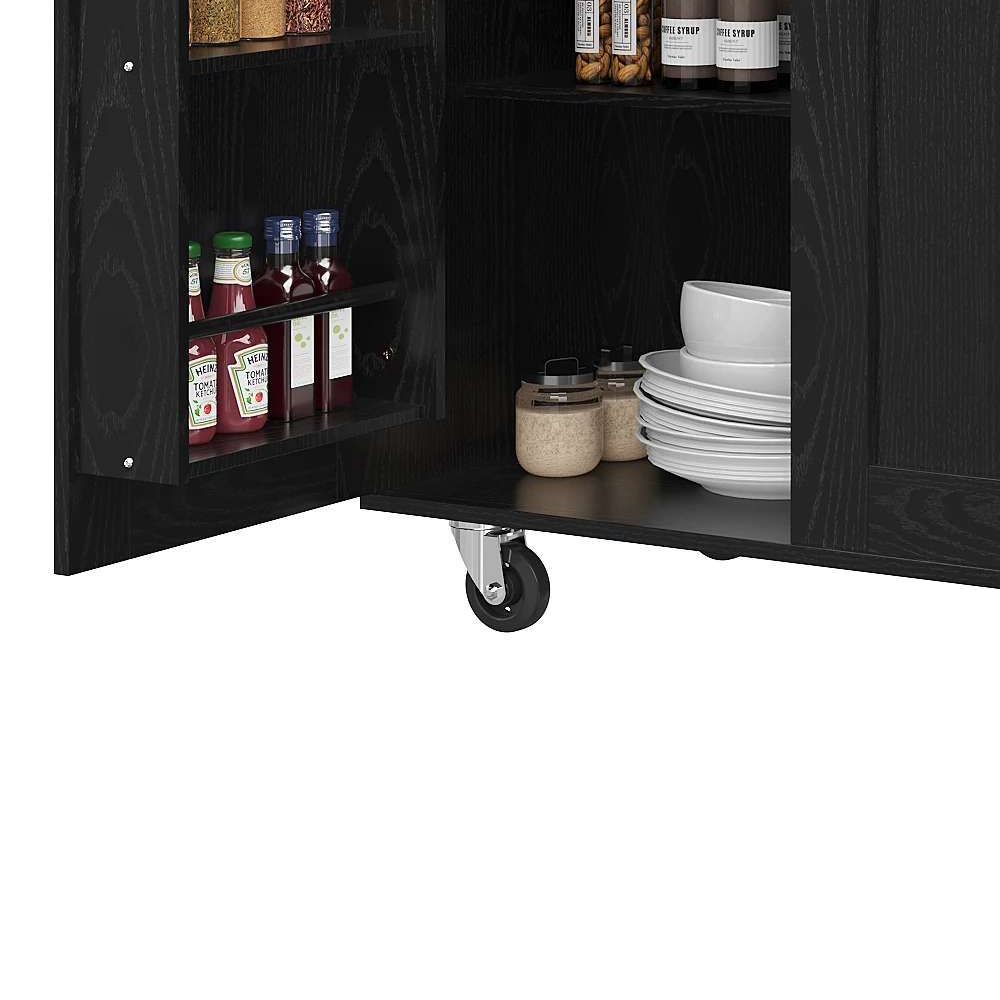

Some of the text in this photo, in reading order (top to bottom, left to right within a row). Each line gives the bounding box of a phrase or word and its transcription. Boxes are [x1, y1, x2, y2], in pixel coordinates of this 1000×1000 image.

[585, 1, 591, 12] 03
[623, 3, 628, 14] 03
[677, 27, 700, 35] SYRUP
[732, 29, 755, 38] SYRUP
[245, 367, 268, 380] TOMAT
[193, 379, 217, 391] TOMAT
